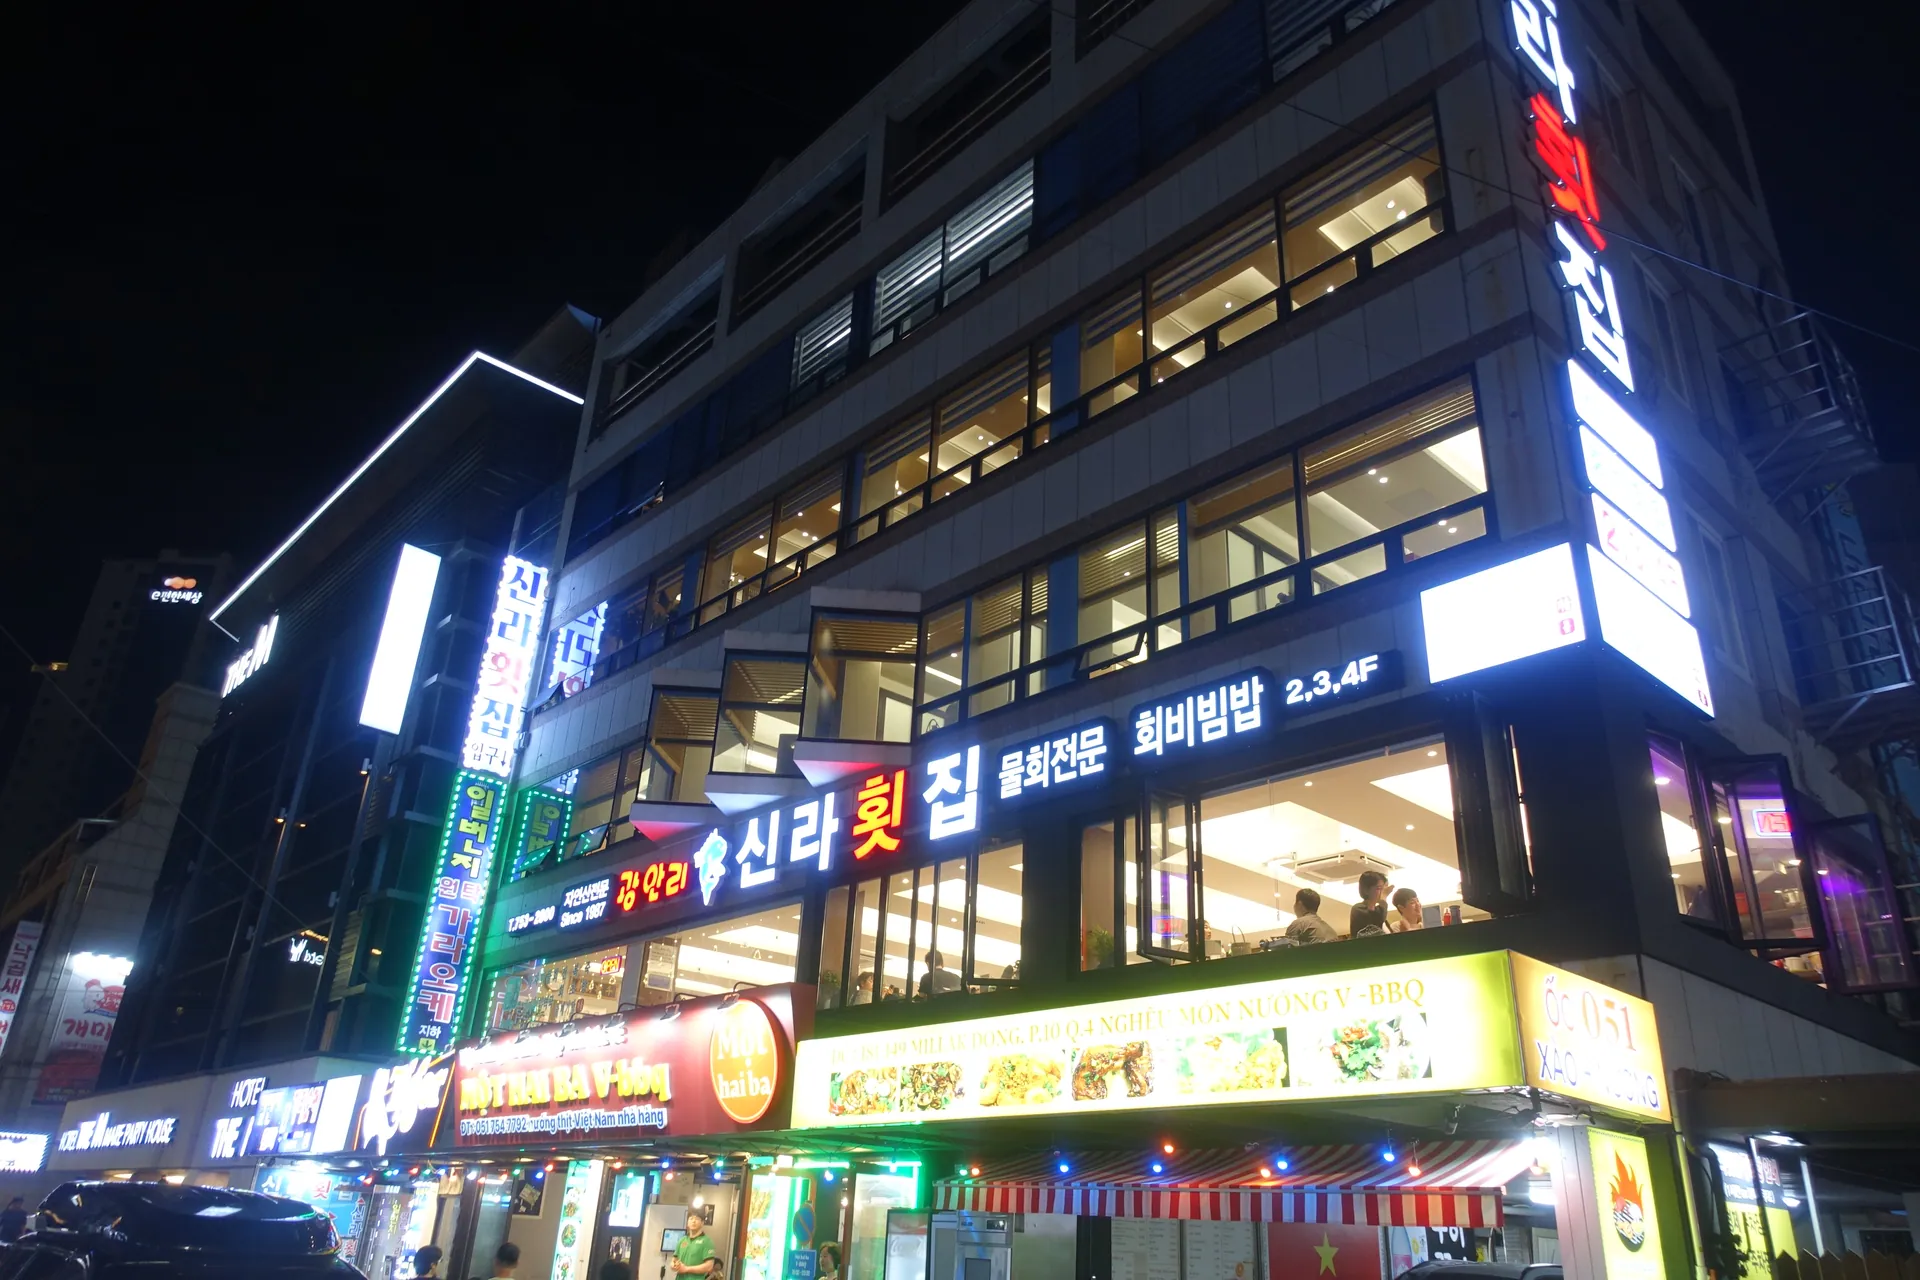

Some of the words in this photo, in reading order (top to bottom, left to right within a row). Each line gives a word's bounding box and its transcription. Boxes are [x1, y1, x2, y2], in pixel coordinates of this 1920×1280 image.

[150, 590, 203, 605] e편한세상
[479, 563, 542, 740] 신라횟집
[1285, 653, 1379, 705] 2,3,4F
[1133, 676, 1265, 756] 회비빔밥
[470, 741, 501, 766] 입구
[997, 725, 1108, 800] 물회전문
[450, 784, 496, 879] 일번지
[735, 744, 982, 889] 신라횟집
[438, 876, 482, 905] 원탁
[616, 860, 689, 912] 광안리
[560, 910, 584, 928] Since
[417, 903, 473, 1024] 가라오케
[601, 957, 619, 974] OPEN
[418, 1024, 442, 1040] 지하
[1029, 1021, 1061, 1044] P.10
[1065, 1019, 1094, 1043] Q.4
[1581, 990, 1638, 1053] 051
[507, 1067, 551, 1107] HAI
[552, 1063, 591, 1102] BA
[591, 1056, 673, 1102] V-bbq
[717, 1071, 747, 1099] hai
[747, 1069, 771, 1096] ba
[122, 1120, 147, 1146] PARTY
[146, 1117, 177, 1145] HOUSE
[211, 1116, 242, 1158] THE
[556, 1112, 573, 1132] thịt
[574, 1110, 593, 1132] Việt
[594, 1110, 616, 1128] Nam
